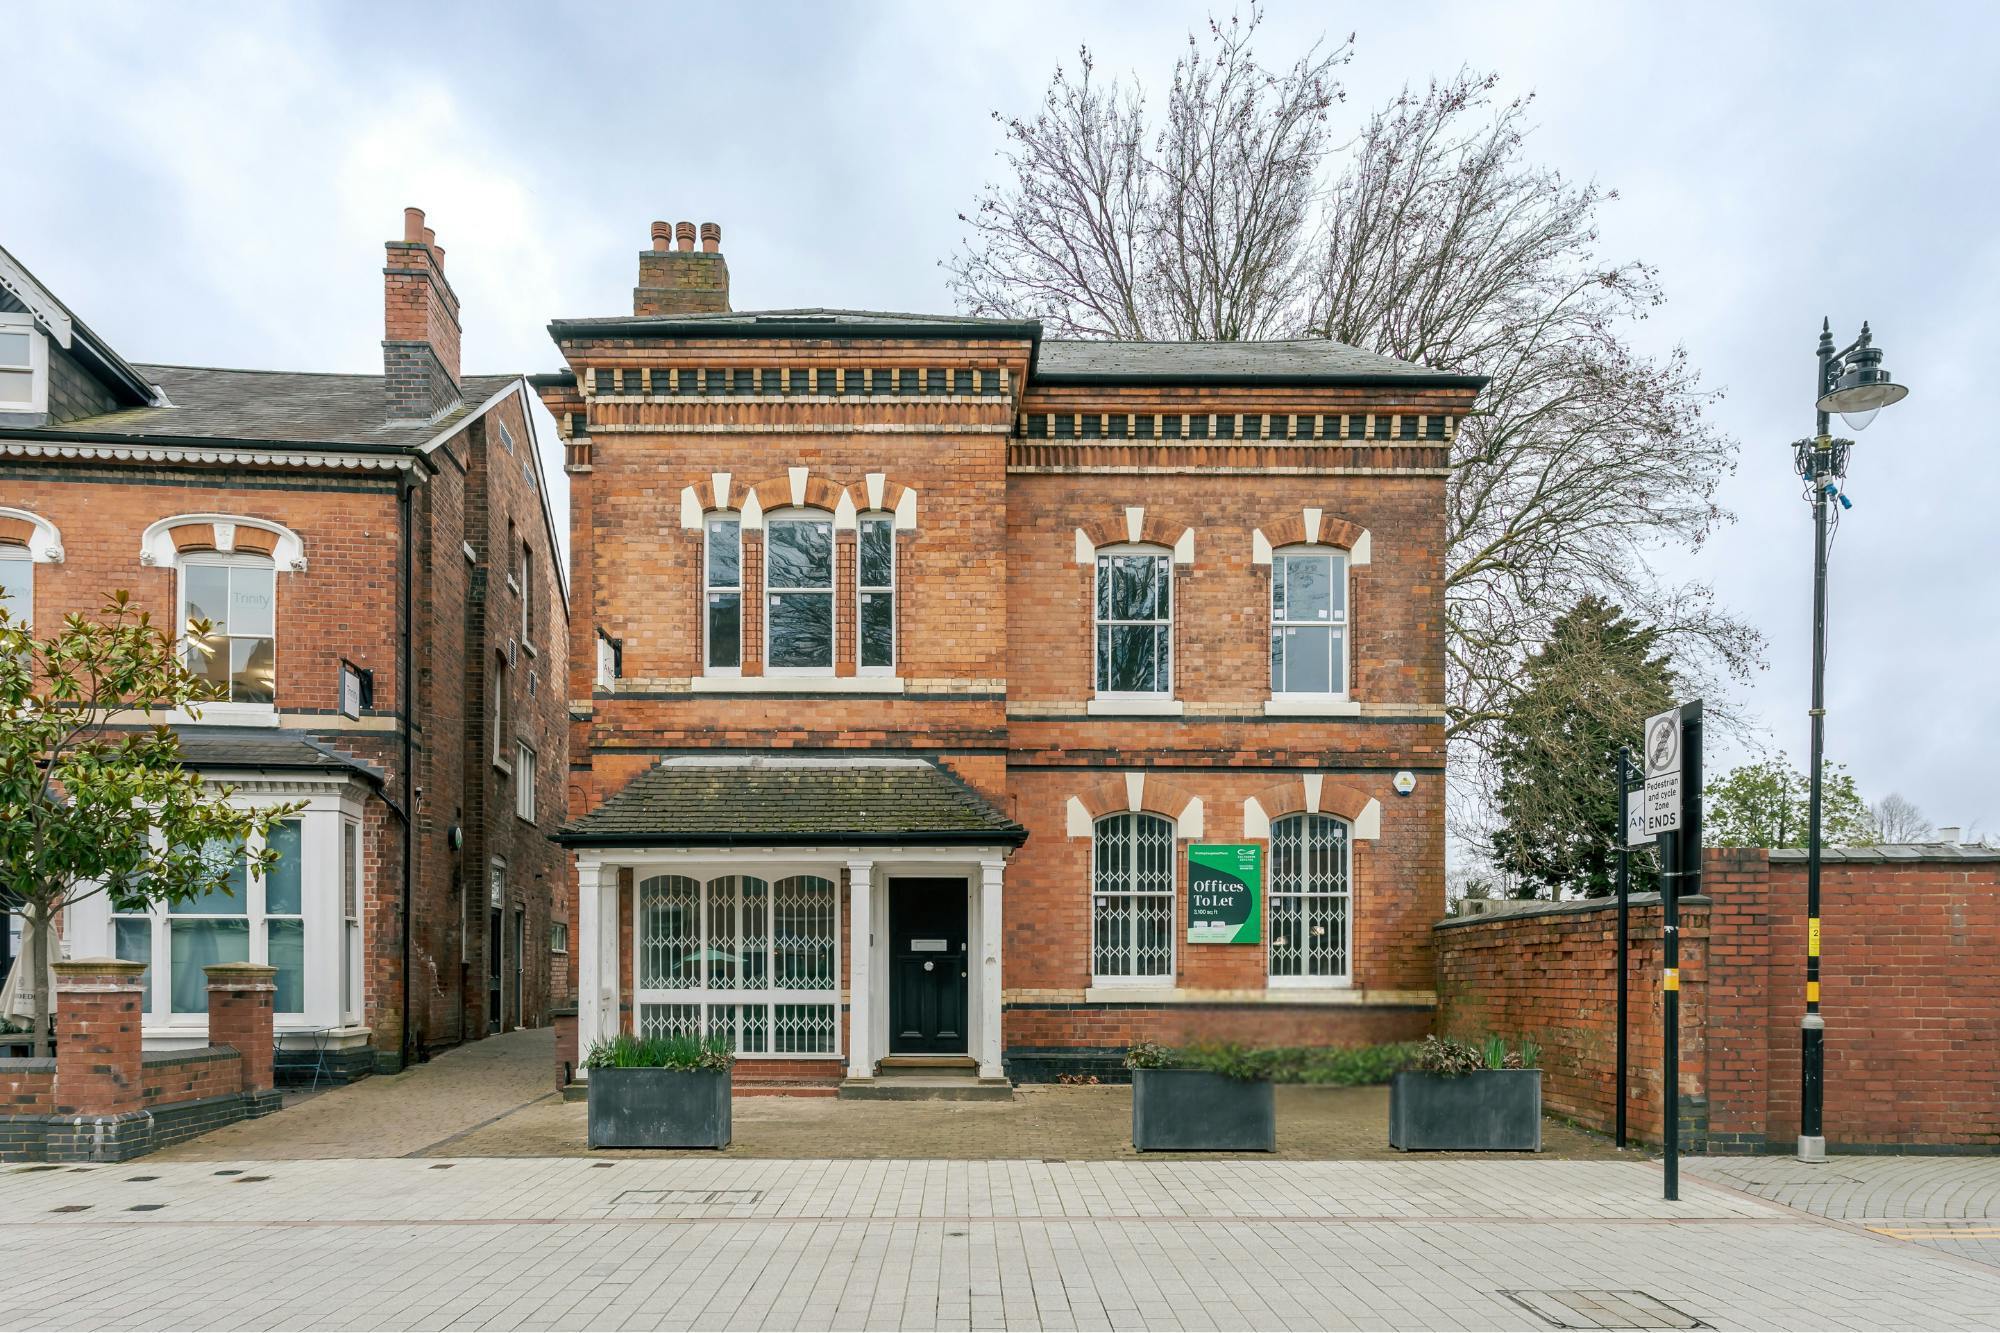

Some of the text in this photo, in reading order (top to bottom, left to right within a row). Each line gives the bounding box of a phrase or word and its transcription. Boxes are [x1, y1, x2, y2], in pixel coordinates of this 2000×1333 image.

[1647, 778, 1678, 791] Pedestrian
[1648, 788, 1677, 801] and cycle
[1654, 802, 1670, 811] Zone
[1648, 812, 1676, 829] ENDS
[1193, 880, 1244, 892] Offices
[1194, 895, 1234, 906] To Let
[1813, 929, 1819, 937] 2
